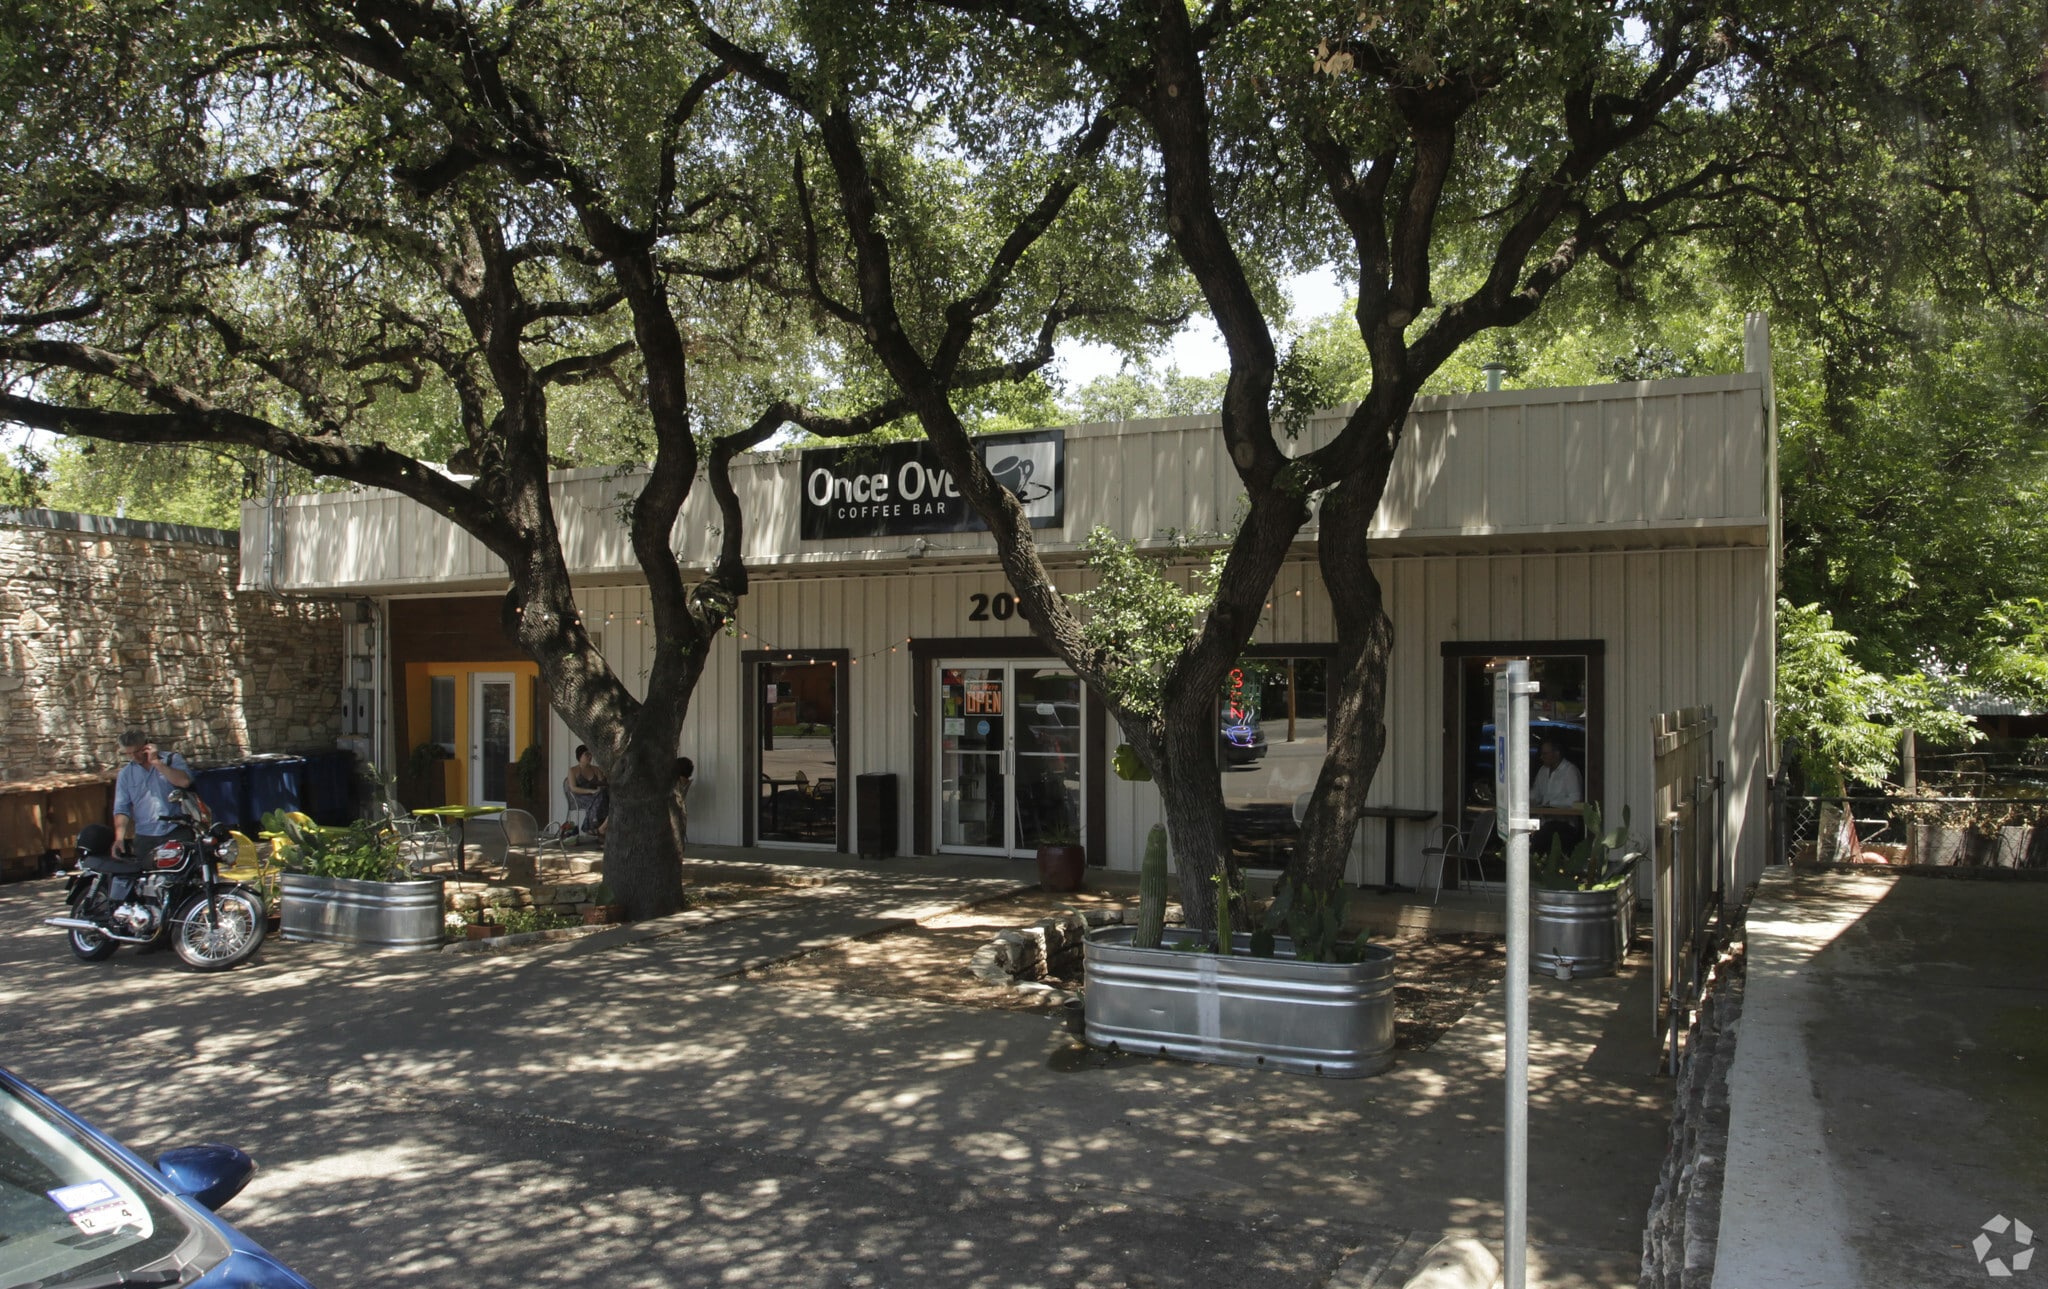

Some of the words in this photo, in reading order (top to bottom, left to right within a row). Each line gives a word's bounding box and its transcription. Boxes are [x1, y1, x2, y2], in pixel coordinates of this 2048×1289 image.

[807, 467, 889, 506] Once
[898, 460, 962, 501] Ove
[838, 504, 901, 520] COFFEE
[913, 502, 946, 515] BAR
[966, 690, 1002, 714] OPEN
[80, 1218, 96, 1229] 12
